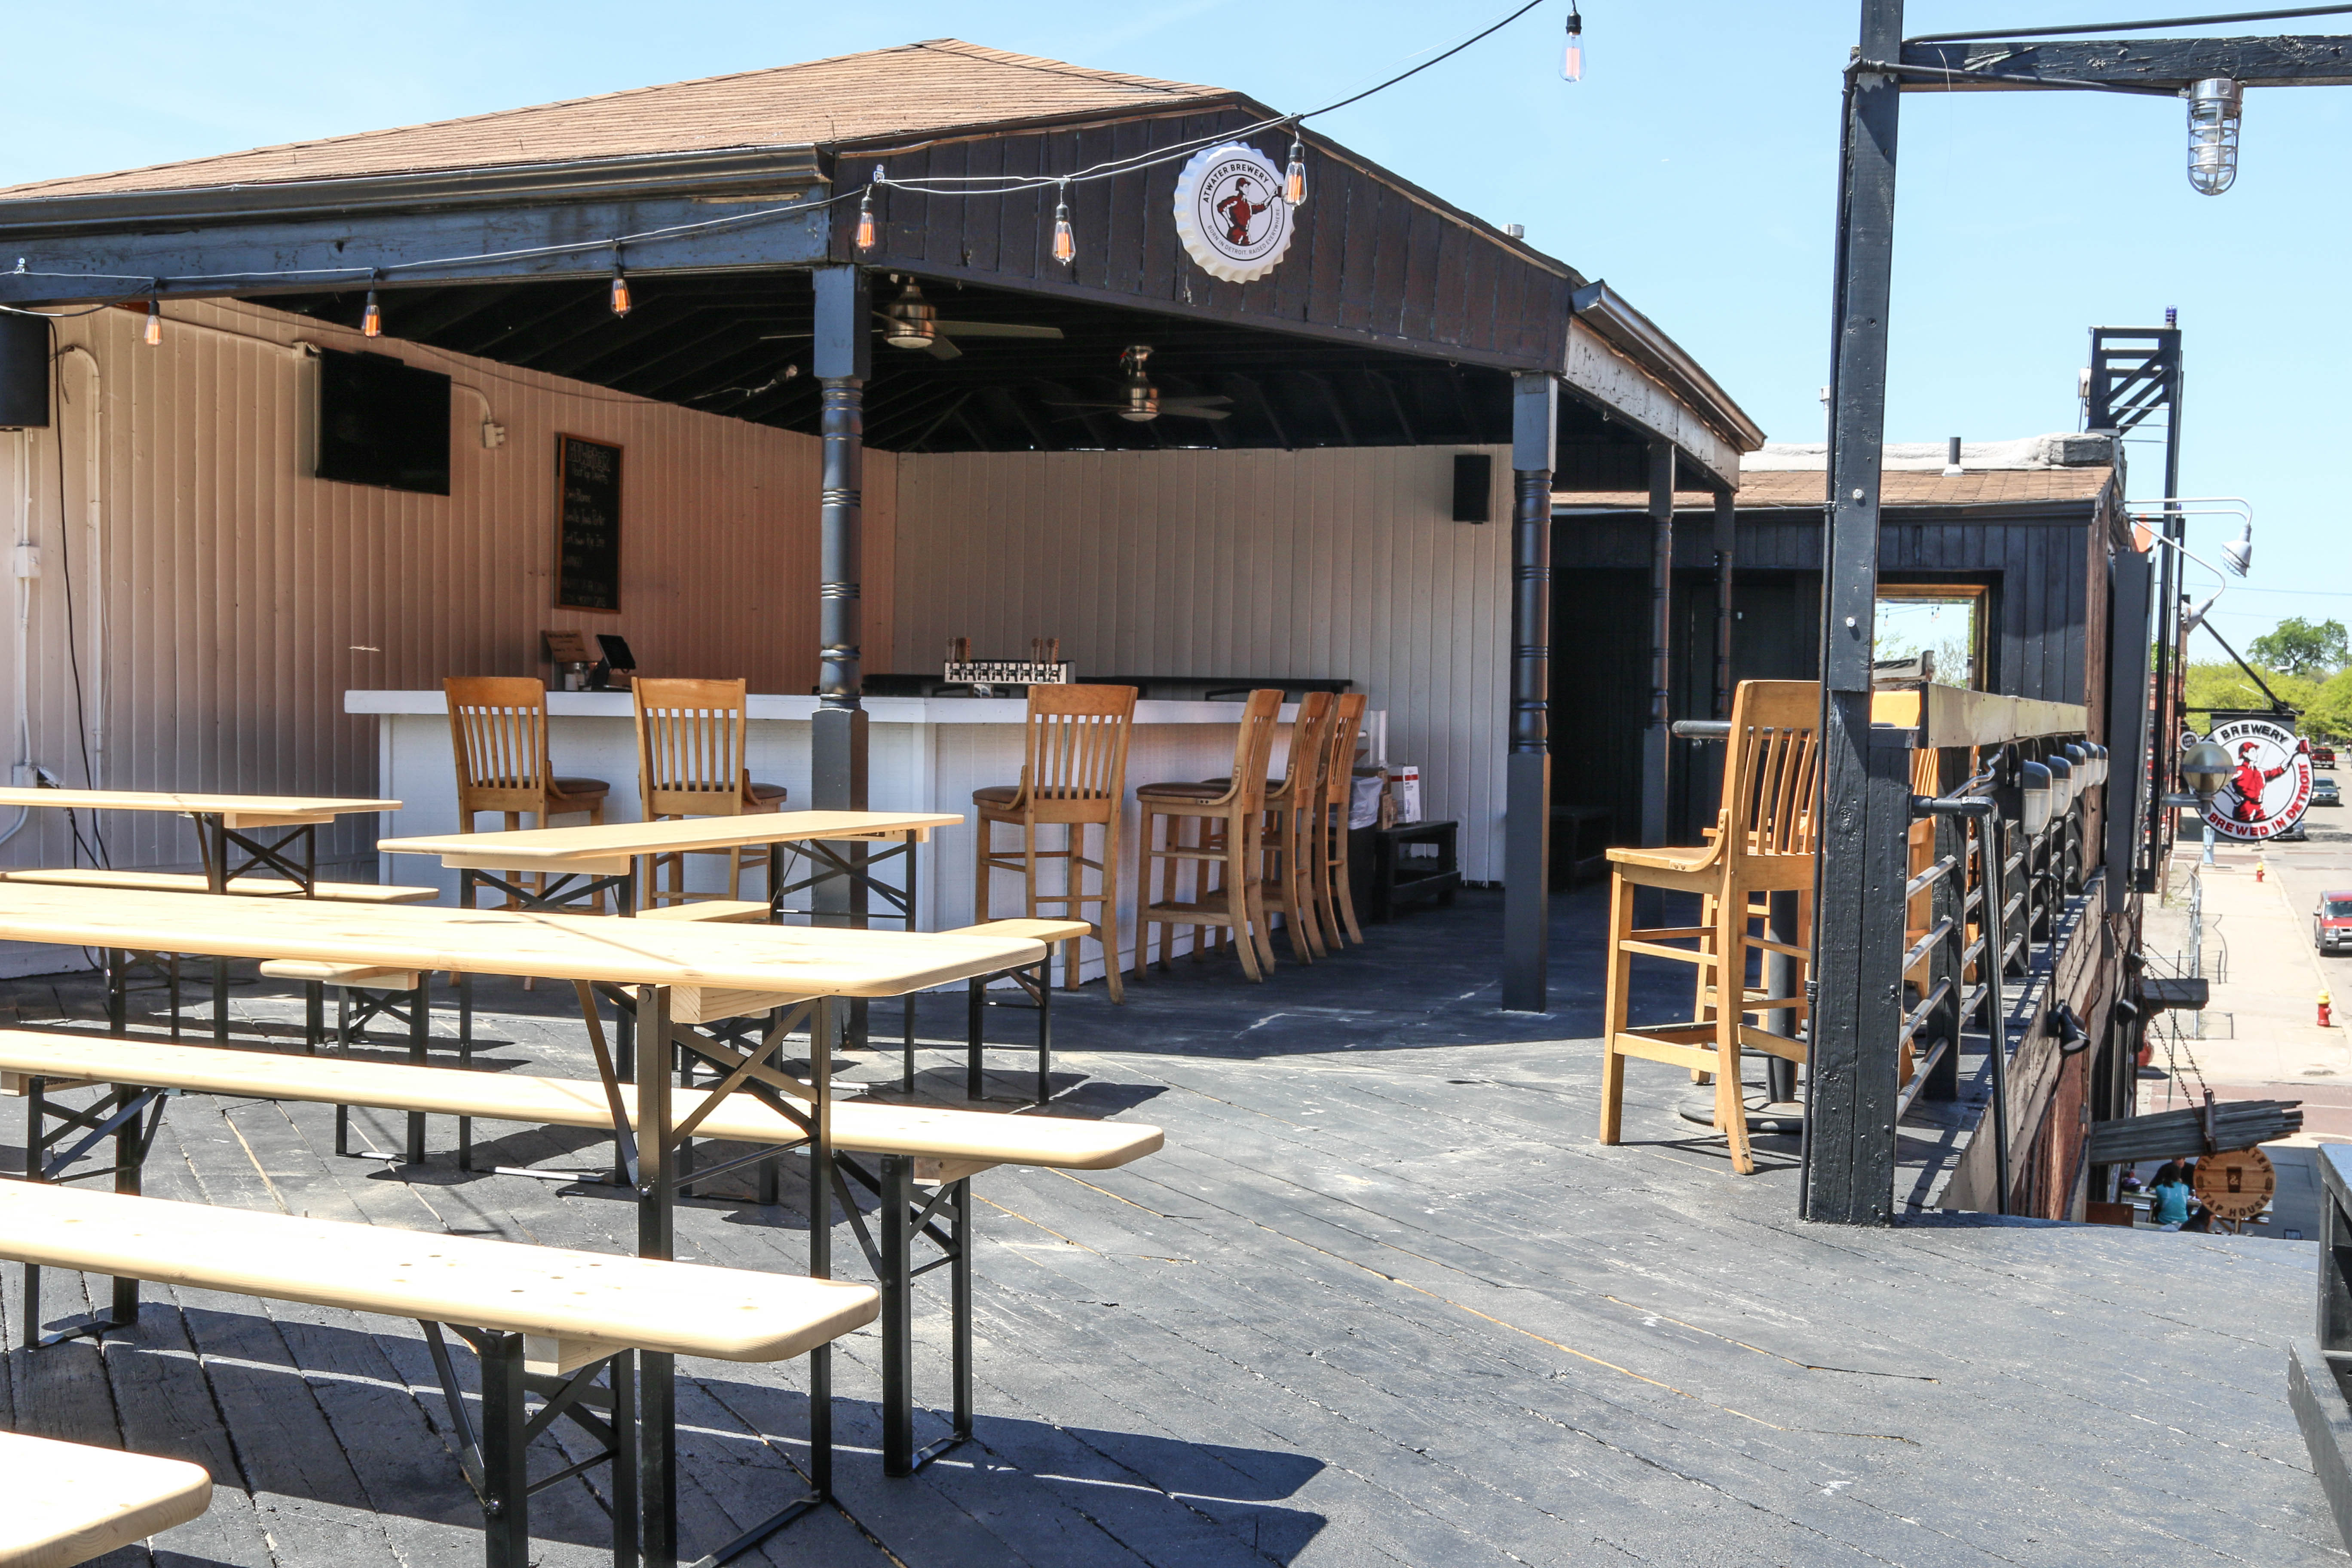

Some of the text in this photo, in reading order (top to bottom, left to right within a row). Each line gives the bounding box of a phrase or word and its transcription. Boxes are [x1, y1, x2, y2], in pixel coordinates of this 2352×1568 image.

[1203, 164, 1269, 203] ATWATER BREWERY
[1208, 225, 1219, 241] BORN
[1225, 245, 1248, 255] DETROIT.
[1249, 243, 1266, 255] RAISED
[2221, 724, 2290, 744] BREWERY
[2208, 762, 2310, 836] BREWED IN DETROIT
[2230, 1175, 2239, 1185] &
[2202, 1193, 2270, 1217] TAP HOUSE
